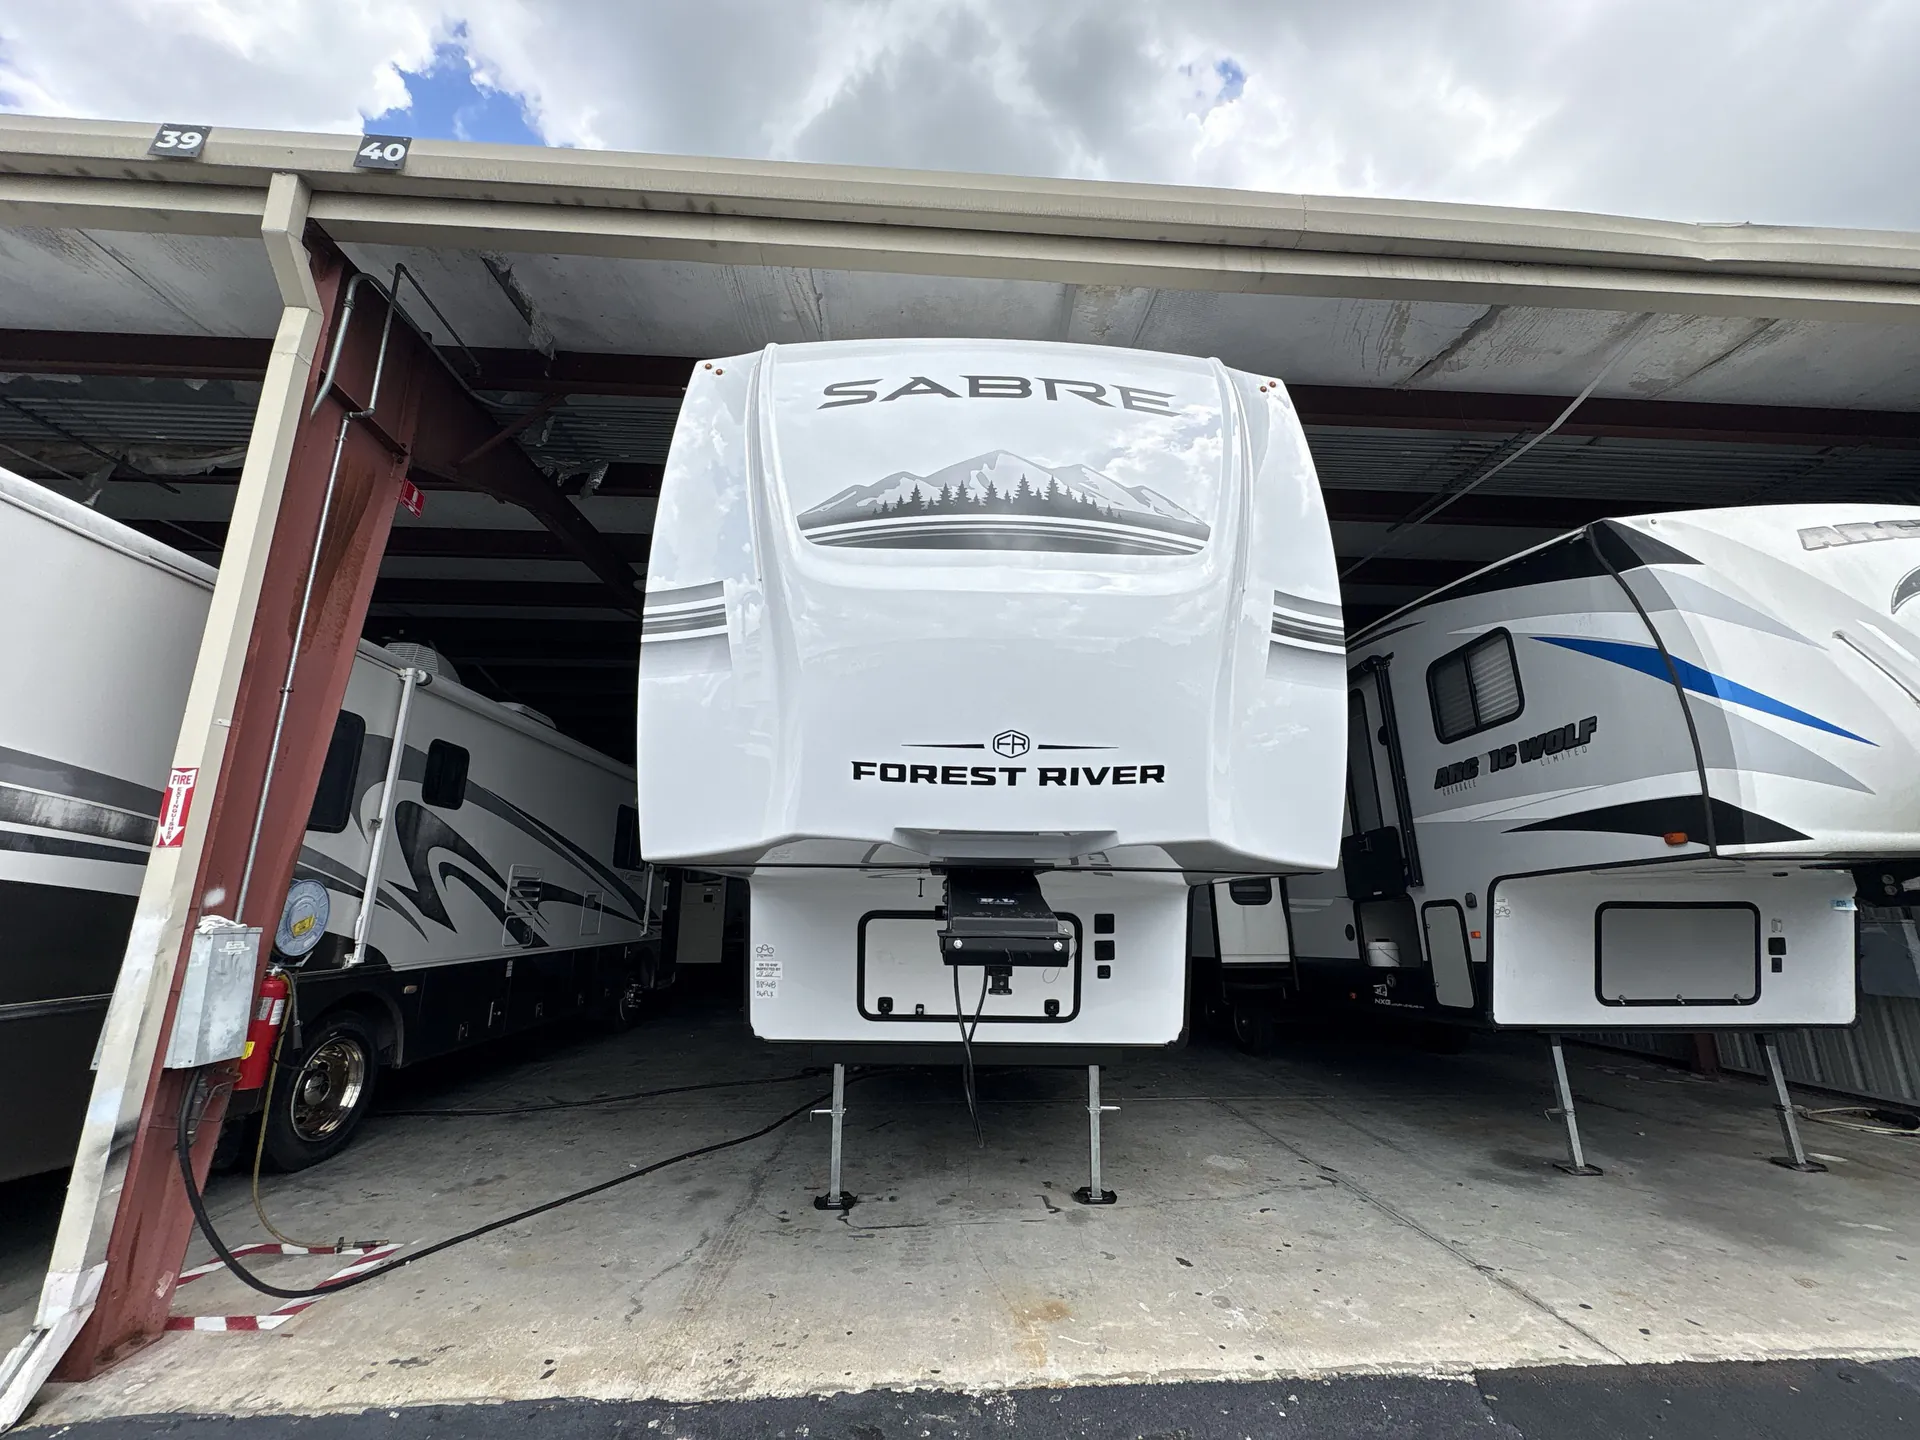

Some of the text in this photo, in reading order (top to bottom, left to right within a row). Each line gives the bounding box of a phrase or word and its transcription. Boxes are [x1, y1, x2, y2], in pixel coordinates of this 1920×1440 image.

[155, 130, 203, 150] 39
[359, 142, 406, 162] 40
[816, 374, 1182, 418] SABRE
[1517, 715, 1598, 764] WOLF
[1540, 745, 1588, 767] LIMITED
[171, 774, 193, 785] FIRE
[851, 761, 1166, 787] FOREST RIVER
[165, 786, 182, 840] EXTINGUISHER
